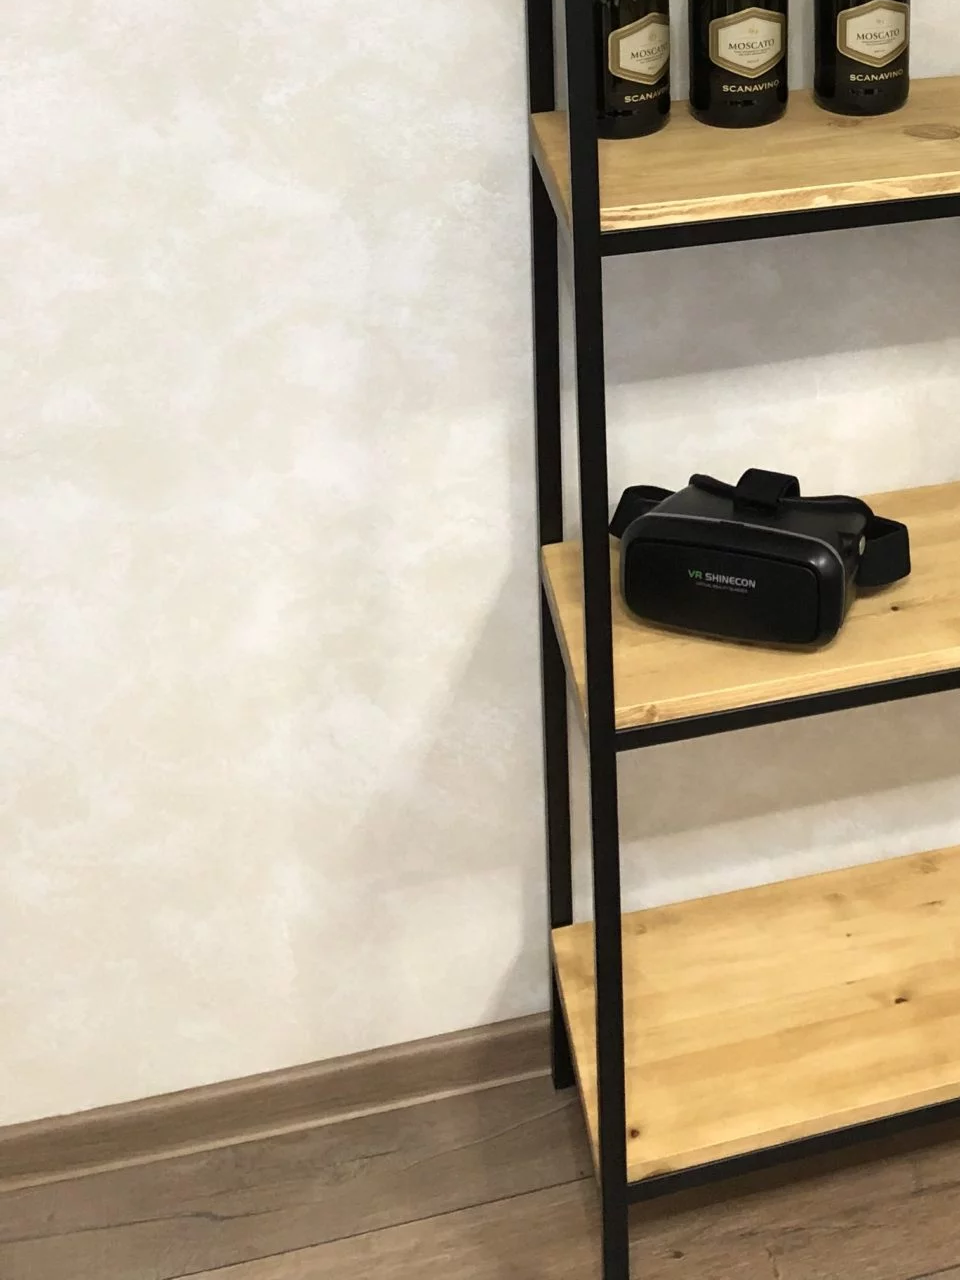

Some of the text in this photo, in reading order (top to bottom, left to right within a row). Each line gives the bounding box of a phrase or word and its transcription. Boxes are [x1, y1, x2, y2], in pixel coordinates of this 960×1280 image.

[856, 27, 900, 41] MOSCATO
[728, 38, 776, 51] MOSCATO
[849, 68, 904, 82] SCANAVINO
[722, 79, 779, 93] SCANAVINO
[688, 569, 702, 579] VR
[705, 573, 756, 588] SHINECON
